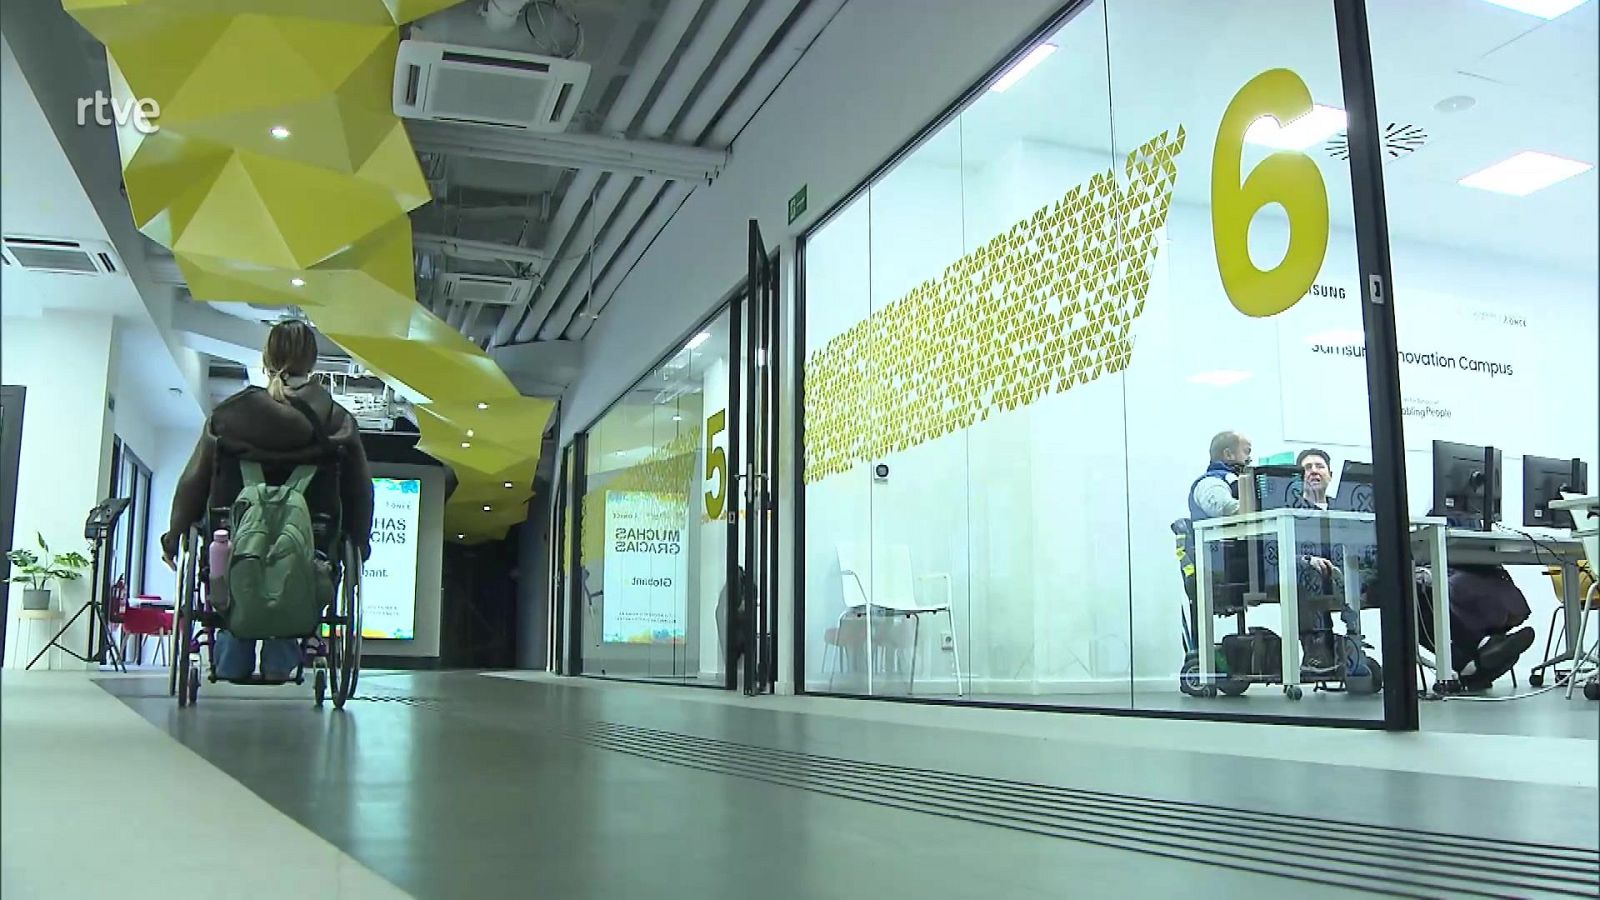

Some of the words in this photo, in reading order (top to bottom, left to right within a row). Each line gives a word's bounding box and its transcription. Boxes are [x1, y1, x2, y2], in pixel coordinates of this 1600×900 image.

[1211, 68, 1330, 317] 6
[1309, 284, 1346, 299] SUNG
[1398, 351, 1456, 369] novation
[1458, 356, 1514, 378] Campus
[704, 408, 727, 520] 5
[374, 517, 406, 531] HAS
[371, 531, 406, 544] CIAS
